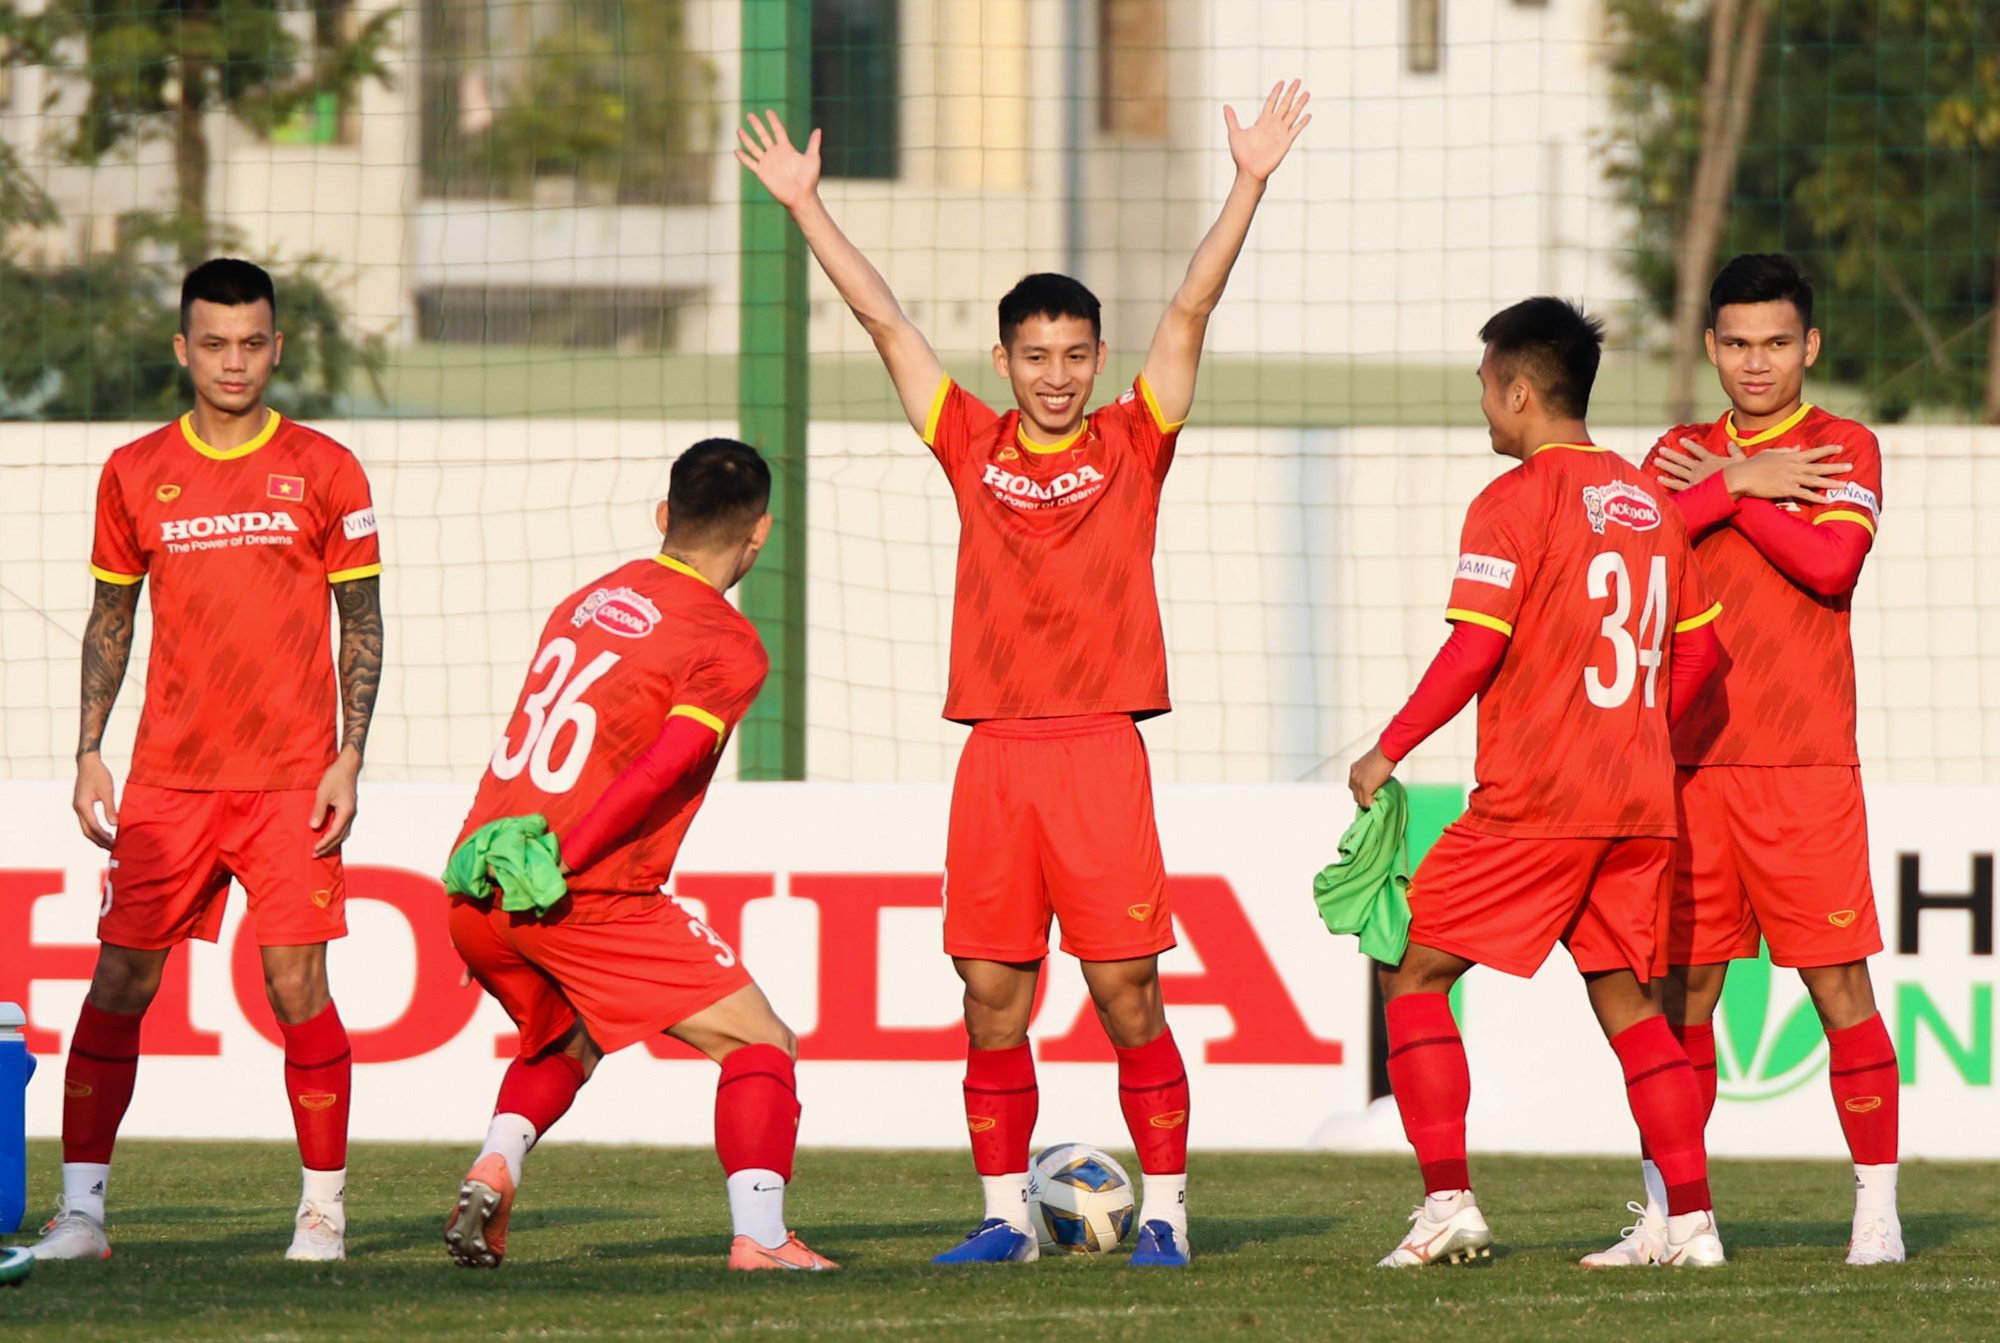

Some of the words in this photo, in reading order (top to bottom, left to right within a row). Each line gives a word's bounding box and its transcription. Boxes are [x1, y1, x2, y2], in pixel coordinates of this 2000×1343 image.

[983, 464, 1104, 500] HONDA
[1003, 495, 1040, 510] Power
[160, 511, 299, 542] HONDA
[167, 543, 190, 553] The
[191, 538, 228, 551] Power
[230, 535, 243, 547] of
[245, 534, 293, 546] Dreams
[1584, 551, 1667, 708] 34
[490, 636, 622, 794] 36
